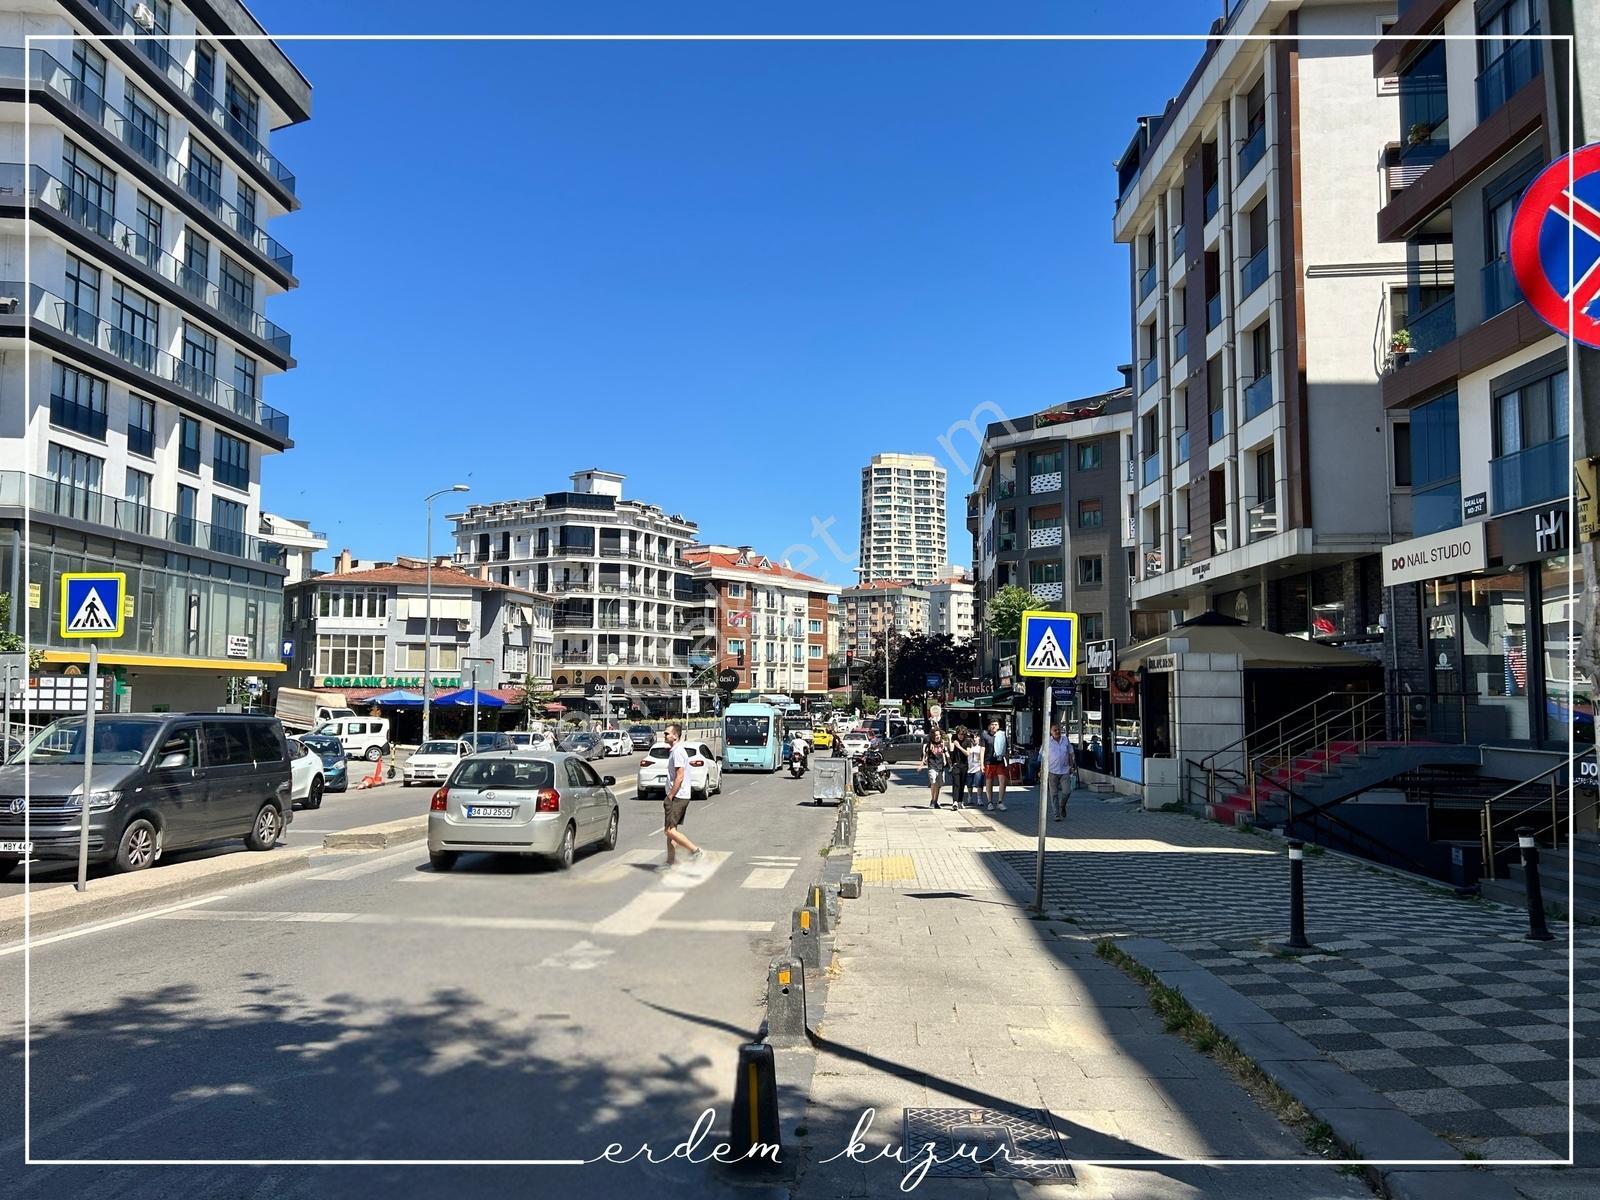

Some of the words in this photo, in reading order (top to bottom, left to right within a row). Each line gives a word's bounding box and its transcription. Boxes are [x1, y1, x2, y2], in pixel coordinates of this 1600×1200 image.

[1391, 556, 1405, 571] DO
[1407, 551, 1428, 567] NAIL
[1430, 541, 1471, 562] STUDIO
[431, 676, 462, 688] AZA
[1580, 761, 1598, 777] DO
